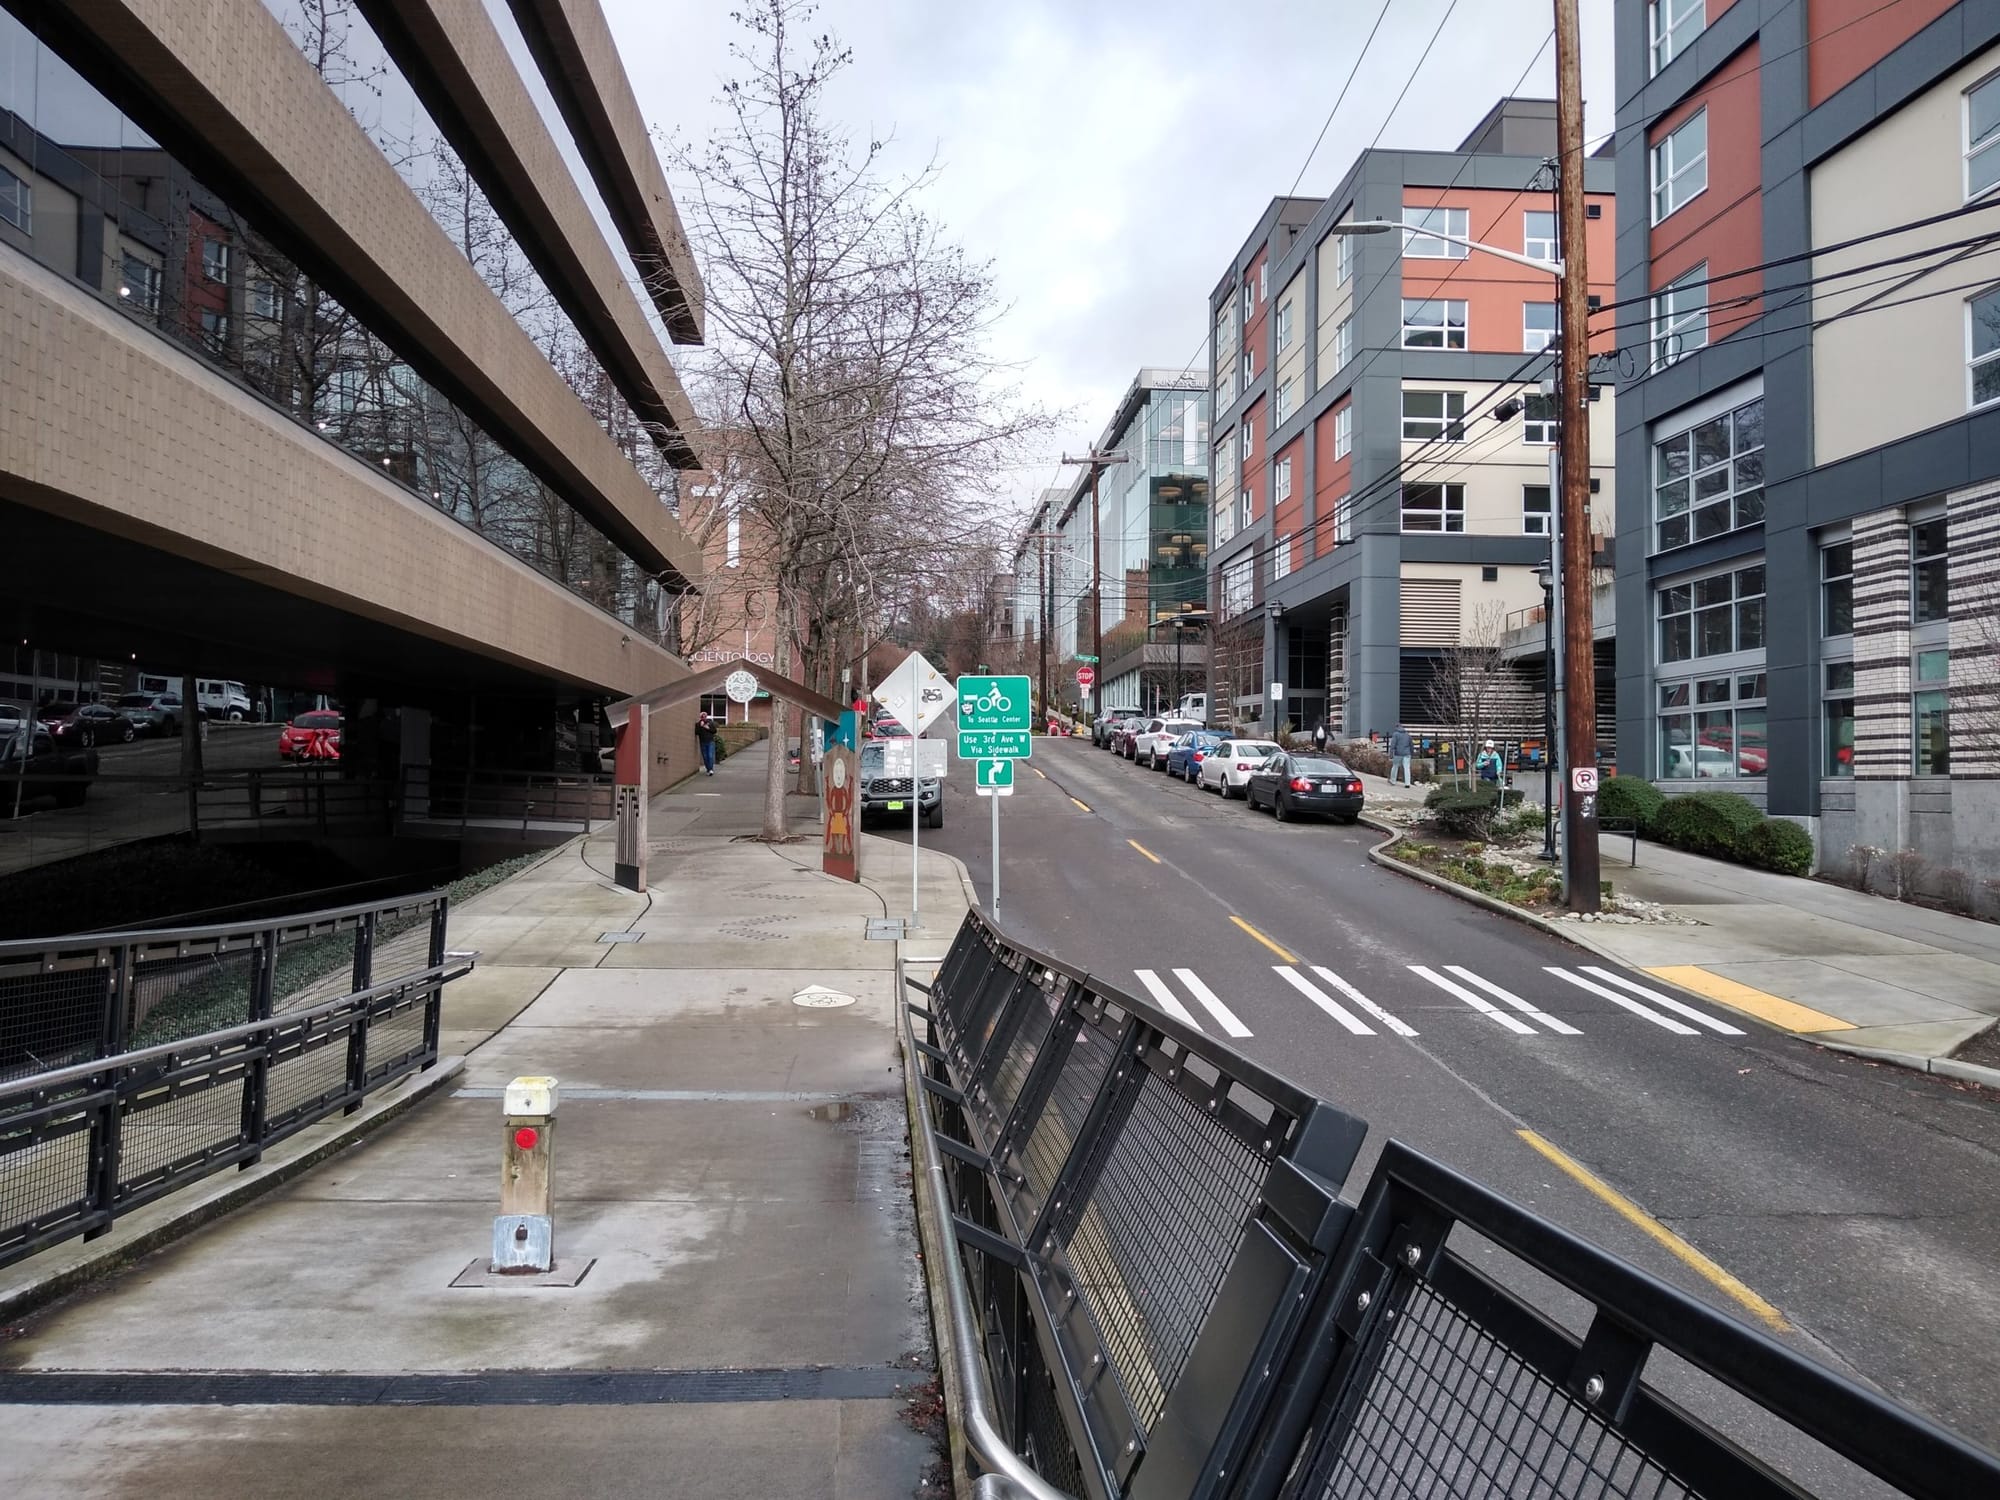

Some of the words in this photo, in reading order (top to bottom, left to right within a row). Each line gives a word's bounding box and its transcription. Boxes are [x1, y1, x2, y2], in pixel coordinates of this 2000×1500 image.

[1078, 672, 1093, 680] STOP
[963, 735, 978, 743] Use
[982, 735, 996, 743] 3rd
[1000, 735, 1014, 743] Ave
[1019, 734, 1026, 743] W
[970, 746, 983, 754] Via
[987, 746, 1019, 754] Sidewalk
